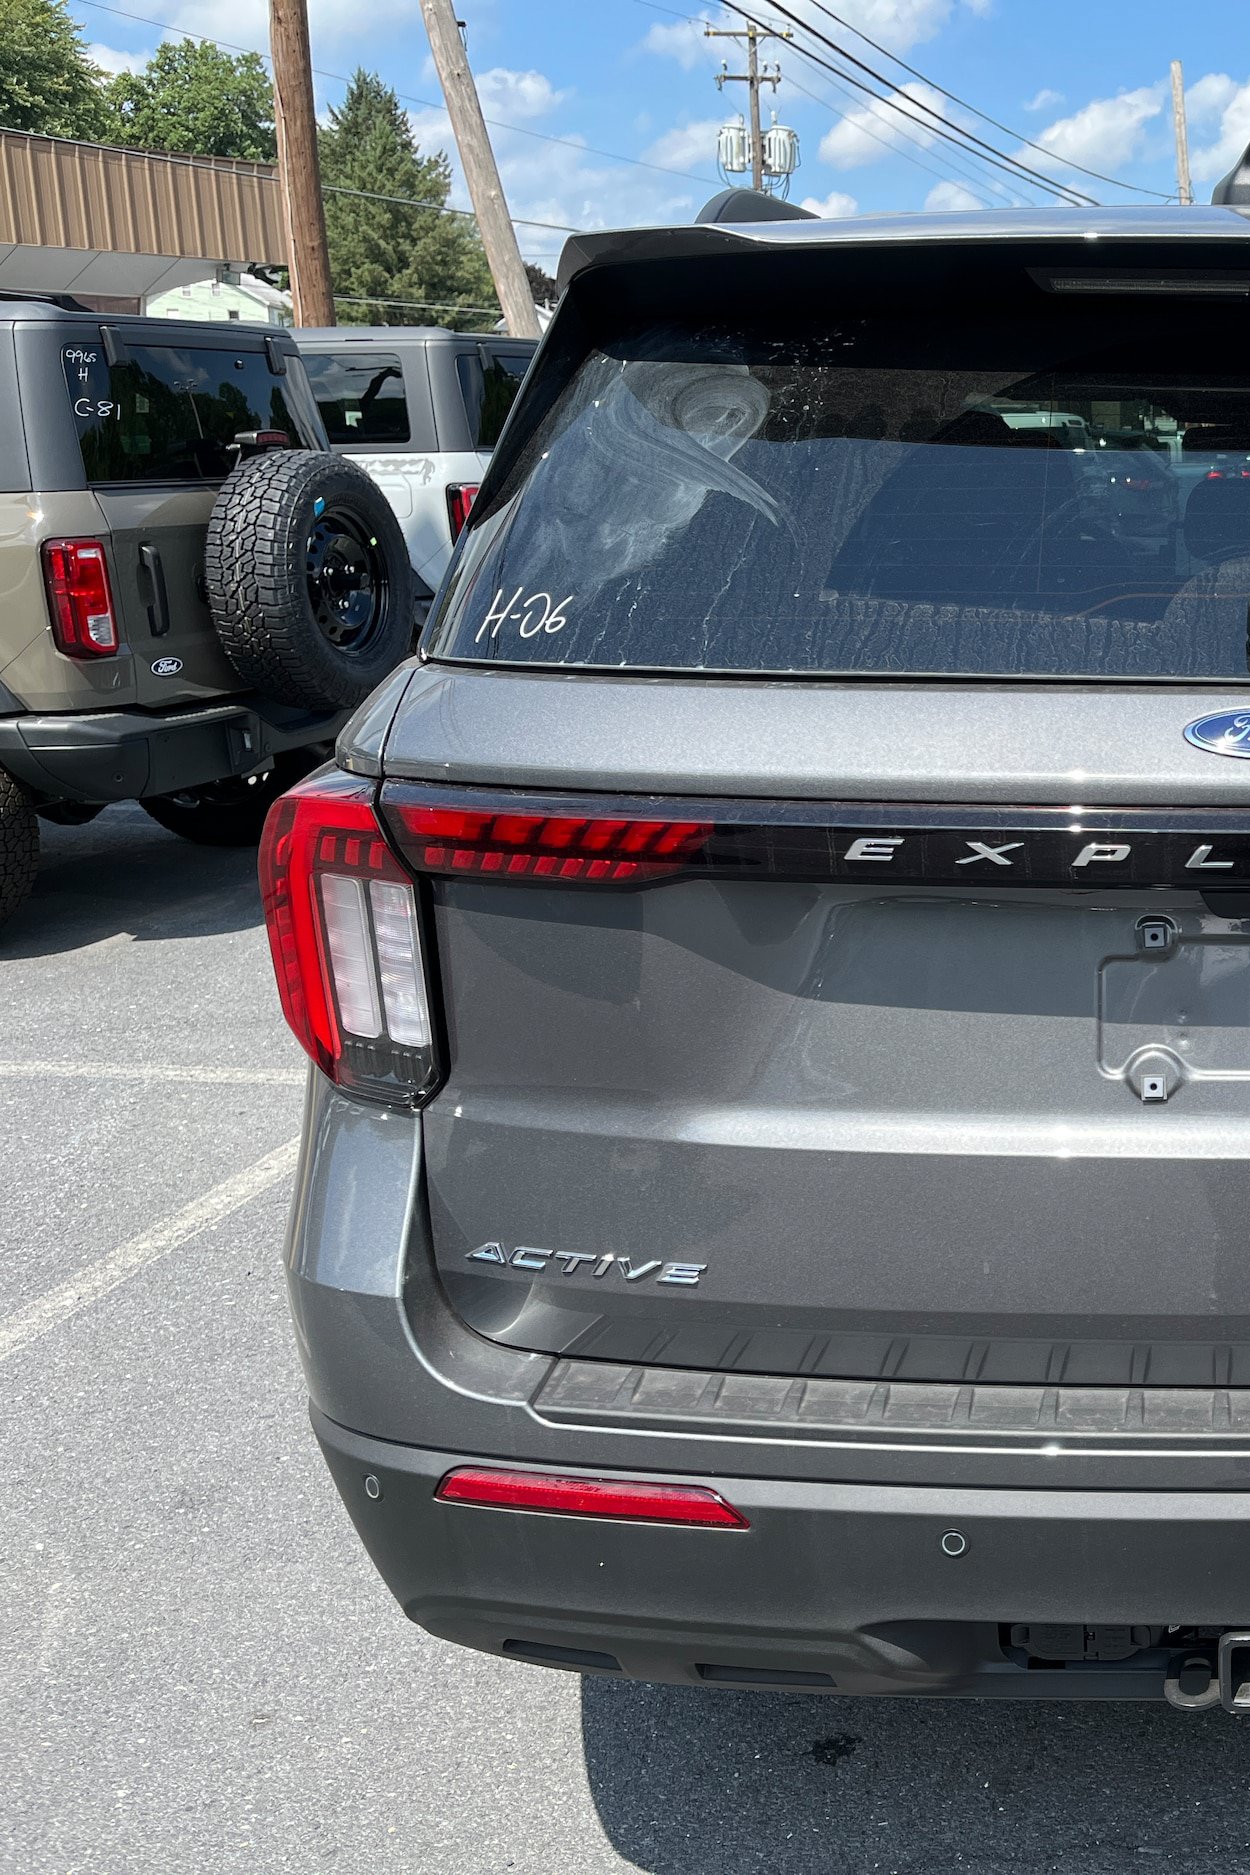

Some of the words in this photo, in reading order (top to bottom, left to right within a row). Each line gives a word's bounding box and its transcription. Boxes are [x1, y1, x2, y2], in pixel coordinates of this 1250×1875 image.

[78, 367, 88, 382] H
[475, 586, 574, 643] H-06
[464, 1241, 708, 1285] ACTIVE
